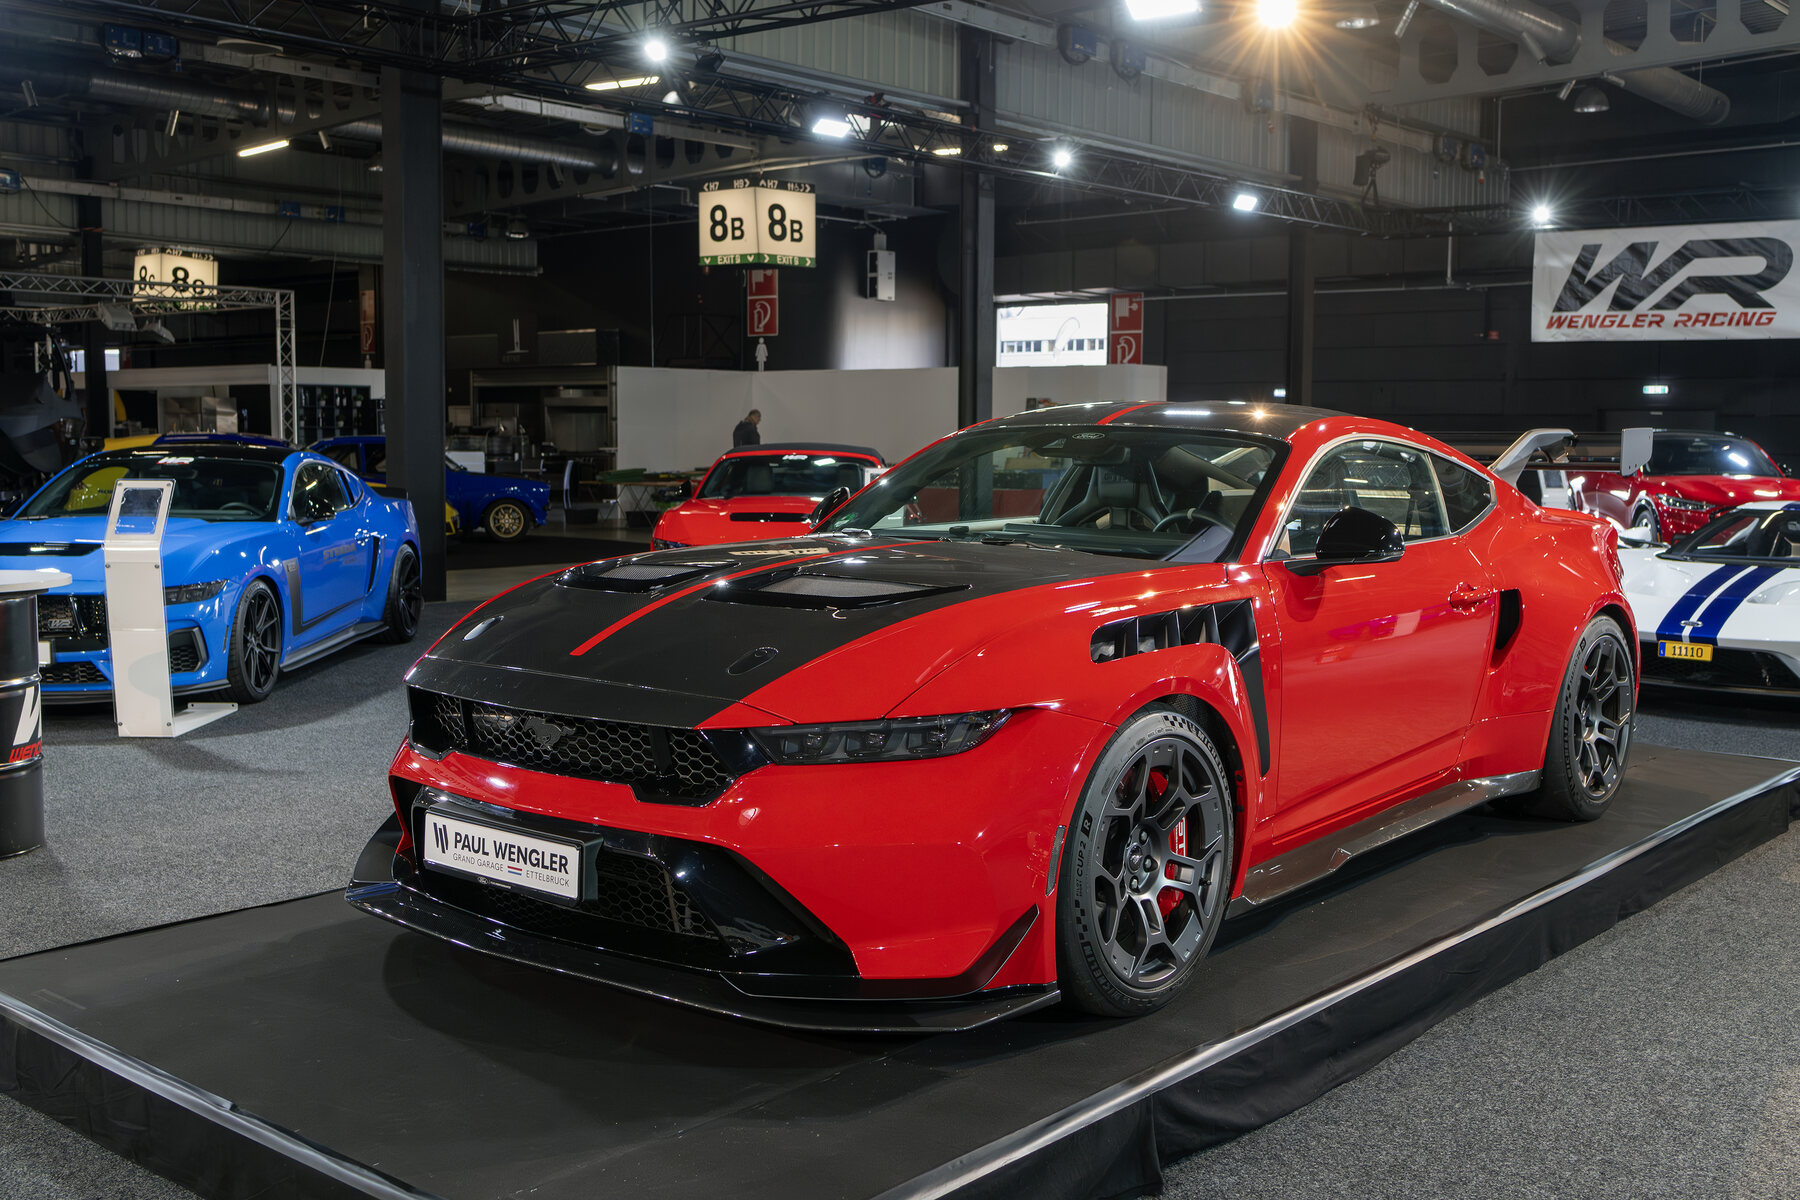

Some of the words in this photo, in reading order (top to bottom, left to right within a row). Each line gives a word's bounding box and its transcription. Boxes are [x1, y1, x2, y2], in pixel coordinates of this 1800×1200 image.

[709, 182, 720, 191] H7
[767, 180, 778, 189] H7
[717, 255, 735, 264] EXIT
[776, 255, 793, 265] EXIT
[1552, 237, 1794, 313] WR
[1545, 314, 1665, 330] WENGLER
[1673, 312, 1777, 328] RACING
[1671, 645, 1704, 658] 11110
[1080, 840, 1087, 850] 2
[454, 831, 489, 857] PAUL
[493, 840, 569, 875] WENGLER
[452, 852, 475, 866] GRAND
[477, 858, 504, 873] GARAGE
[1076, 850, 1085, 878] CUP
[526, 869, 570, 888] ETTELBRUCK
